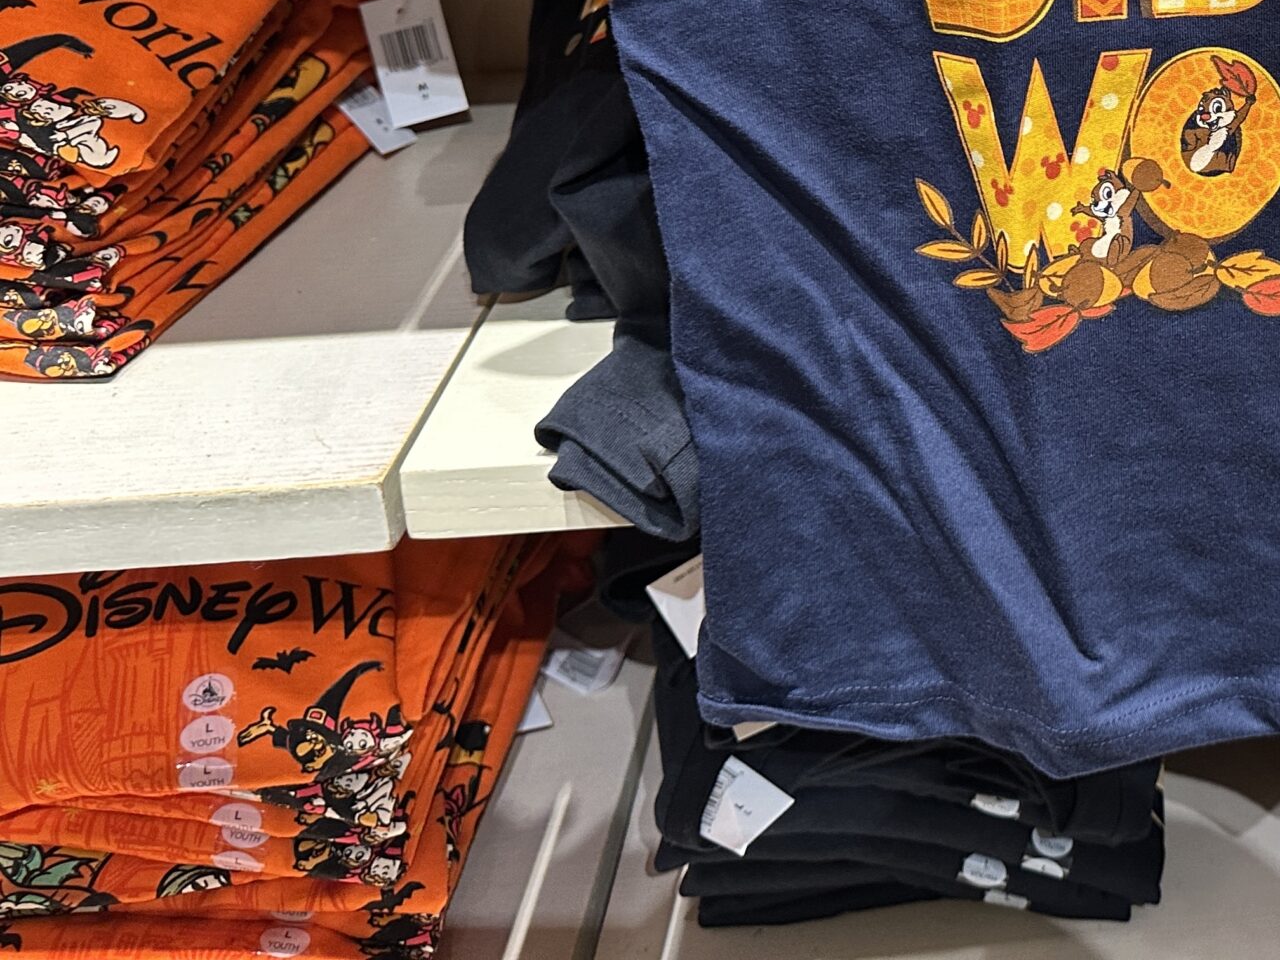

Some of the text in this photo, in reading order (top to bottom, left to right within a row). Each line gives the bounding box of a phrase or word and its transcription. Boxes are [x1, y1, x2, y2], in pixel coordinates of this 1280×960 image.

[206, 723, 213, 733] L
[190, 737, 225, 748] YOUTH
[203, 764, 212, 775] L
[234, 810, 242, 820] L
[229, 829, 261, 843] YOUTH
[285, 931, 292, 939] L
[268, 942, 300, 952] YOUTH
